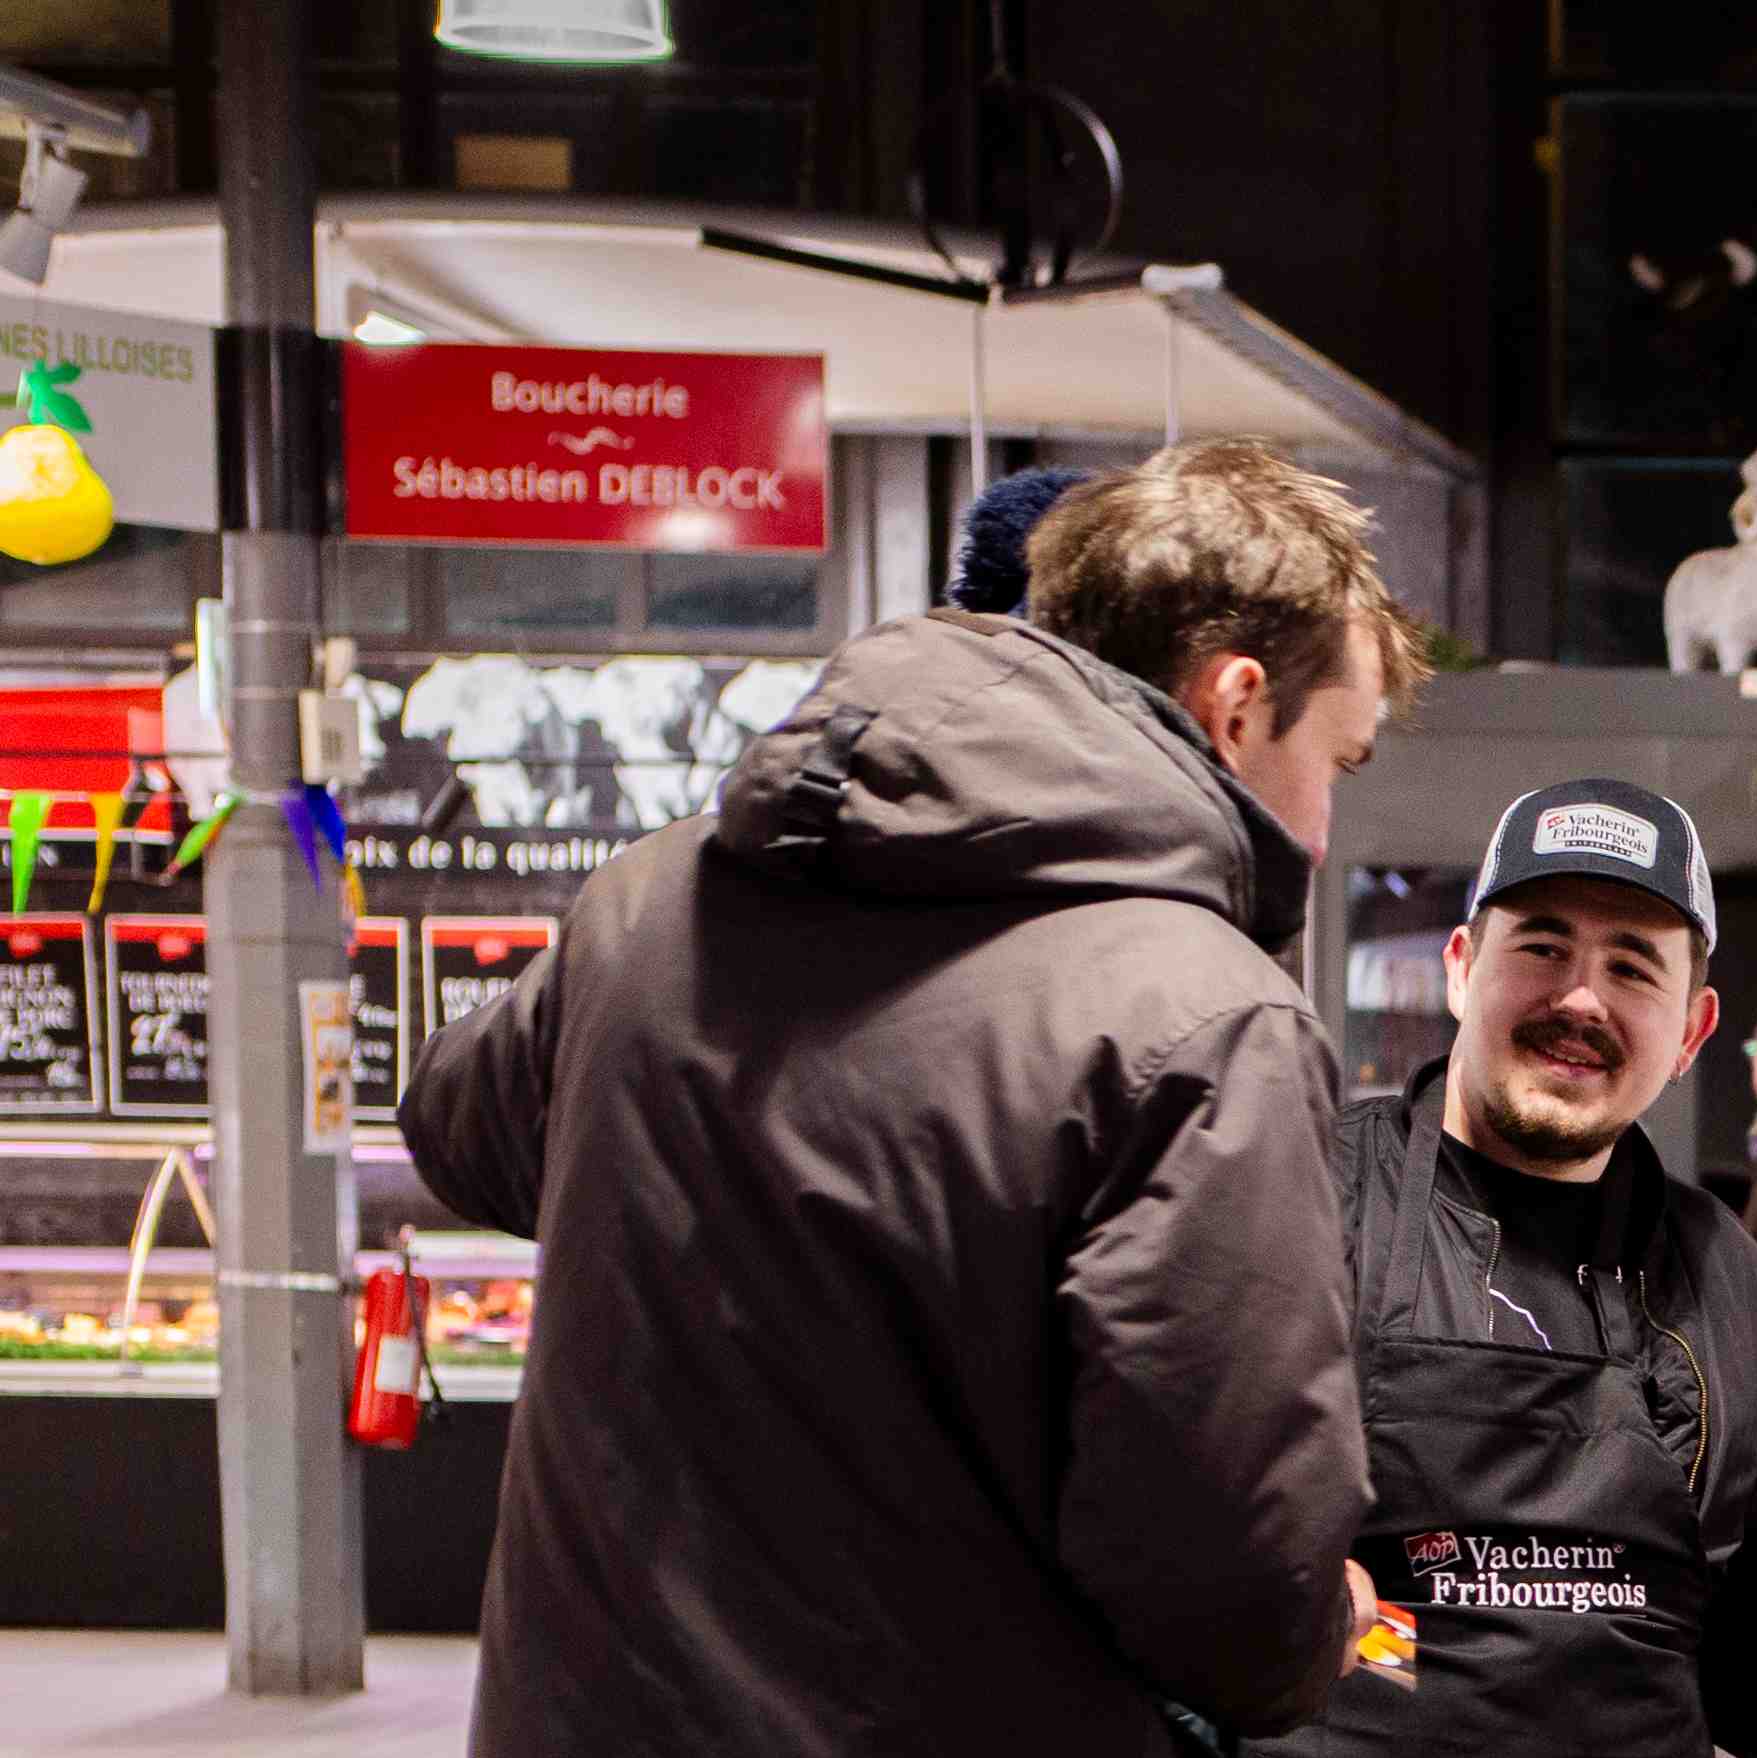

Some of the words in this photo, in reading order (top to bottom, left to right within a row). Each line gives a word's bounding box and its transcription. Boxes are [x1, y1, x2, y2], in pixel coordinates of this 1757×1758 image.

[491, 371, 690, 420] Boucherie
[392, 456, 588, 503] Sébastien
[599, 463, 786, 510] DEBLOCK
[408, 834, 452, 870] de
[461, 834, 497, 870] la
[1552, 825, 1648, 854] Fribourgeois
[1430, 1572, 1647, 1614] Fribourgeois
